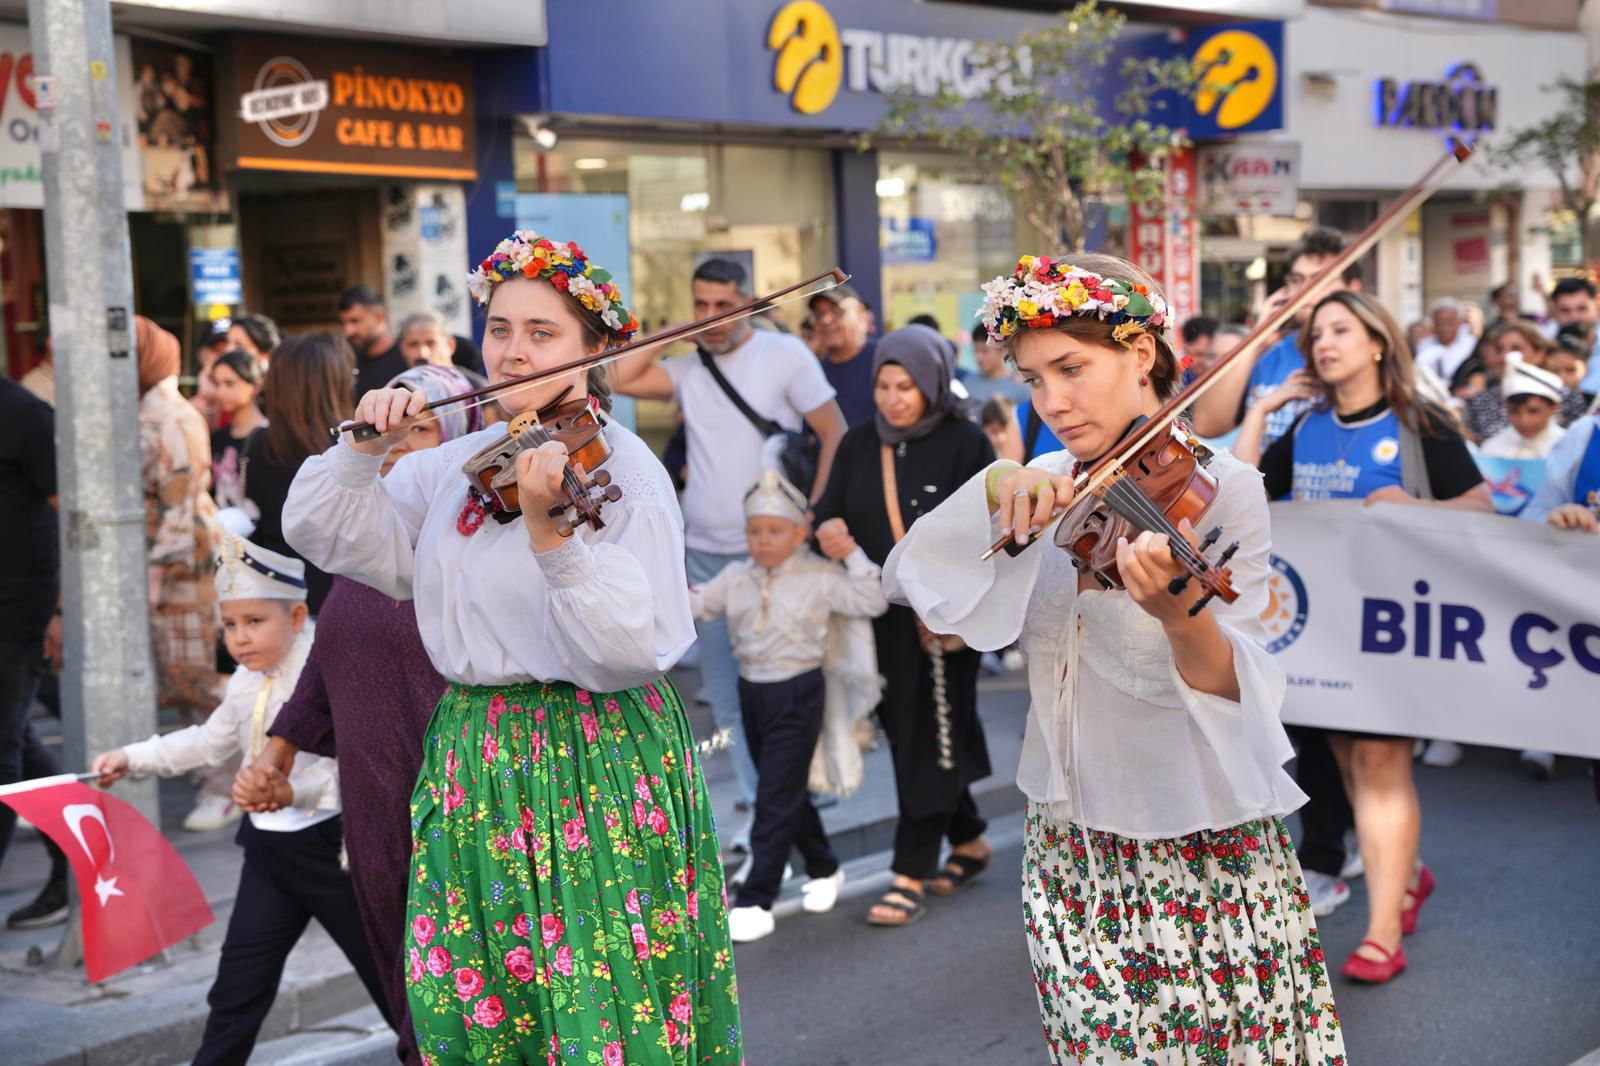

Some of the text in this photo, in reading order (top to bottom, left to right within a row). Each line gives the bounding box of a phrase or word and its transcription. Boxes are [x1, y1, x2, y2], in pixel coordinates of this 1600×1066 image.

[334, 64, 464, 115] PİNOKYO
[336, 118, 463, 152] CAFE & BAR
[1361, 580, 1486, 663] BİR
